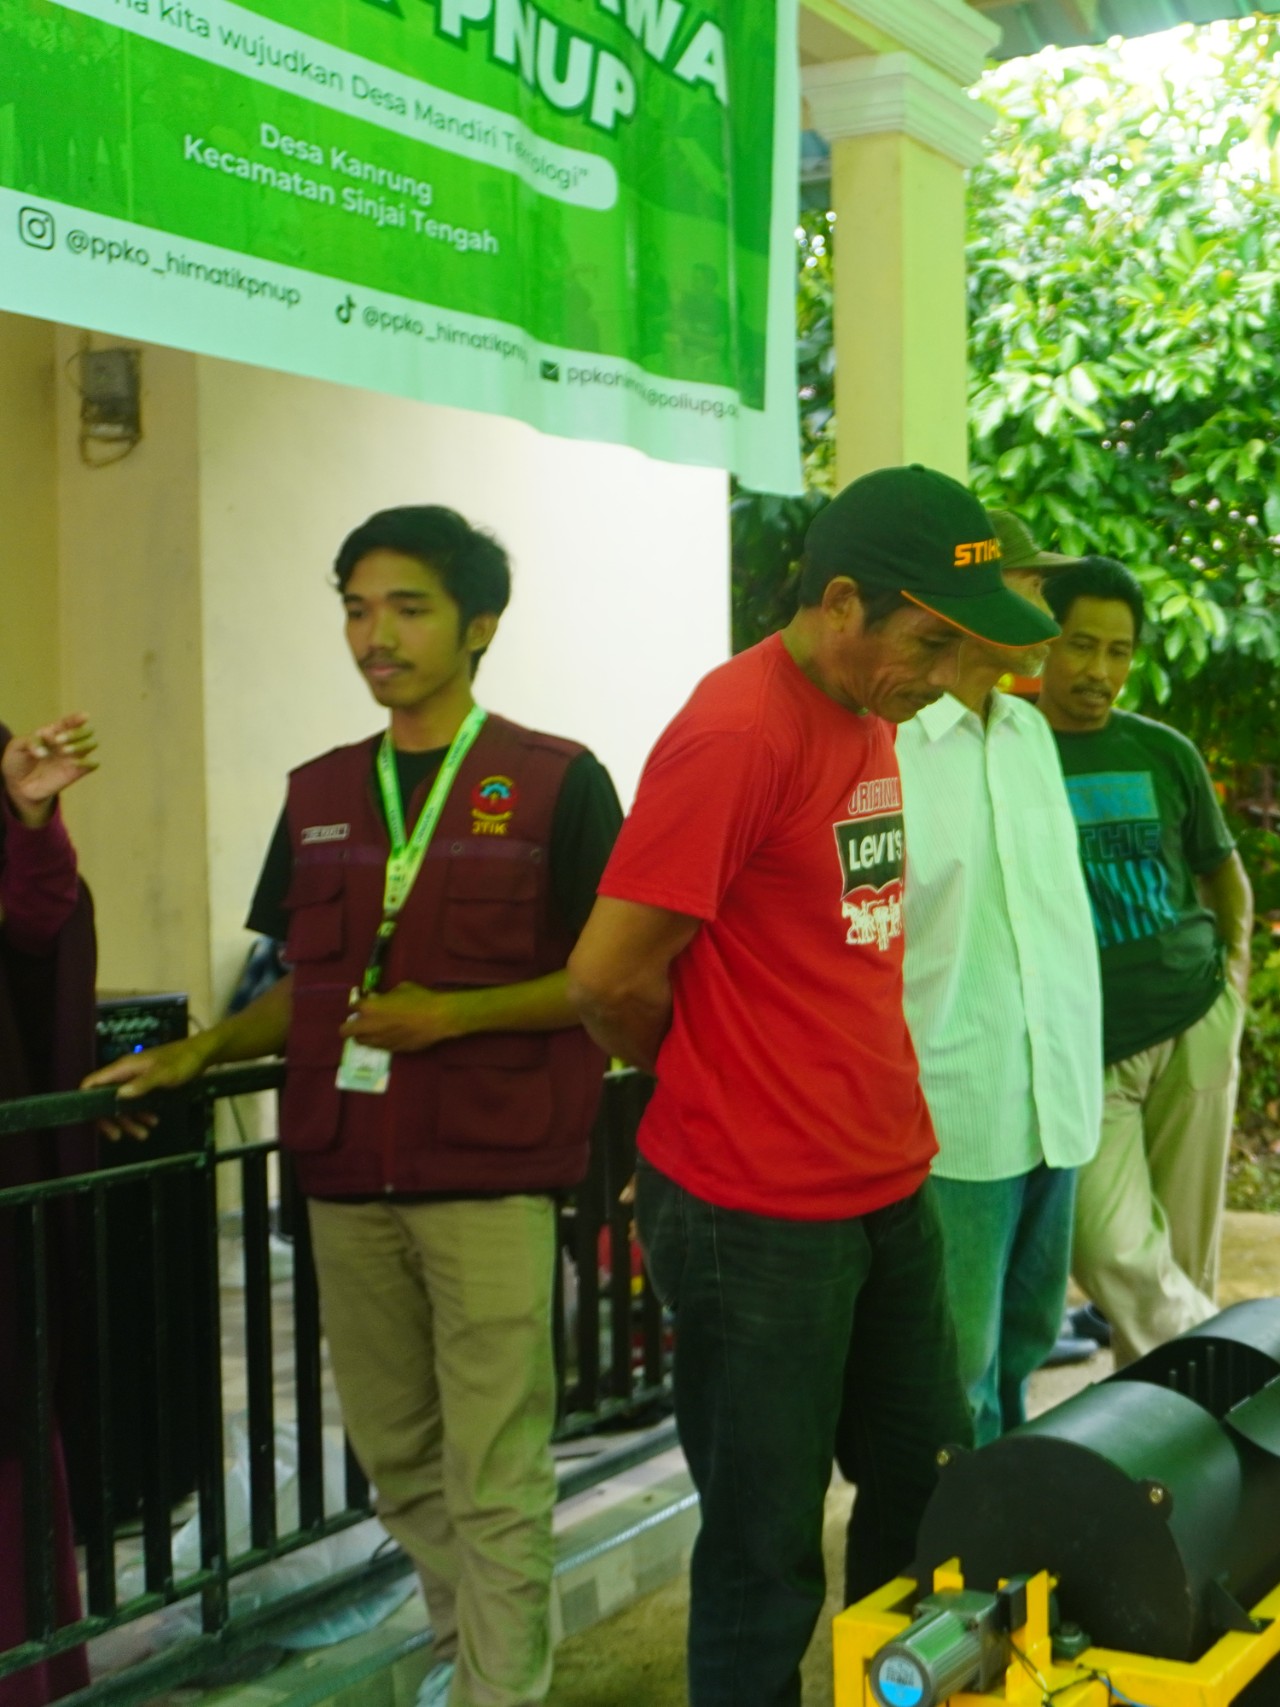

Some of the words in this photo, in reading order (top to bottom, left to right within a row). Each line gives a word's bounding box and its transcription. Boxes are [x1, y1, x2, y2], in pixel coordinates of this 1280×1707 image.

[159, 0, 211, 39] kita
[218, 25, 344, 92] wujudkan
[351, 74, 407, 117] Desa
[413, 99, 498, 148] Mandiri
[183, 133, 336, 206] Kecamatan
[341, 186, 407, 228] Sinjai
[410, 207, 498, 254] Tengah
[259, 121, 324, 166] Desa
[330, 147, 433, 207] Kanrung
